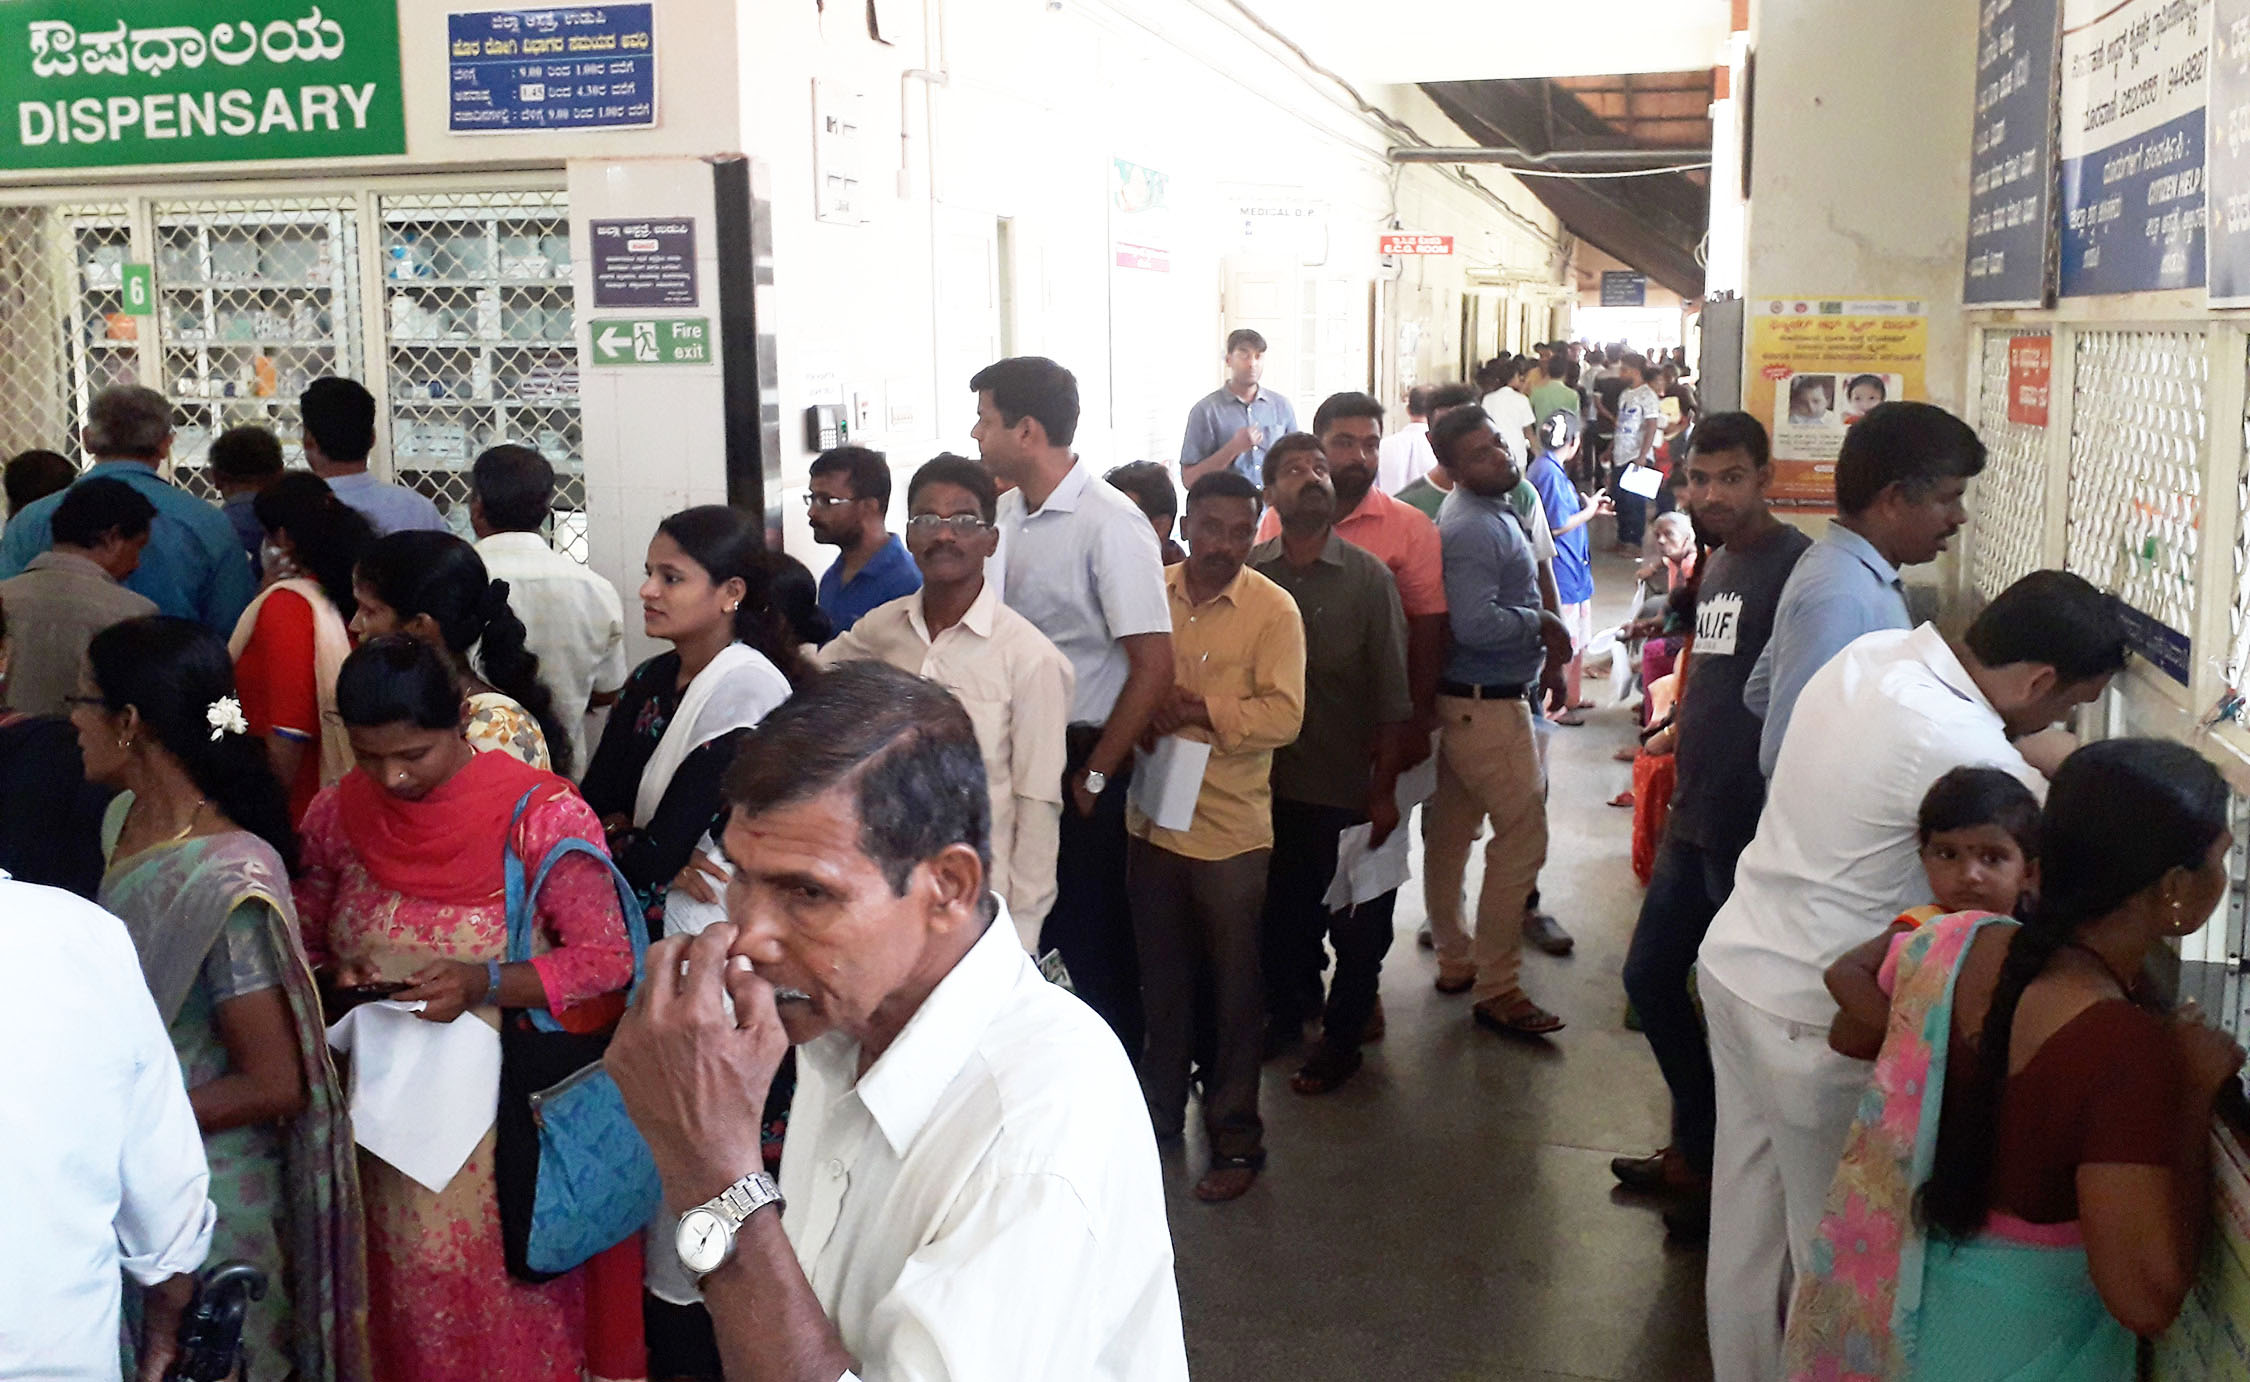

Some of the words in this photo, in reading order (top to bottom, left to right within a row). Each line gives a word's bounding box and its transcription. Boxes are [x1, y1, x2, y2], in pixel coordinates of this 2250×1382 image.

[28, 5, 346, 78] ಔಷಧಾಲಯ
[18, 82, 377, 146] DISPENSARY
[130, 275, 145, 306] 6
[672, 322, 702, 339] Fire
[674, 343, 704, 360] exit
